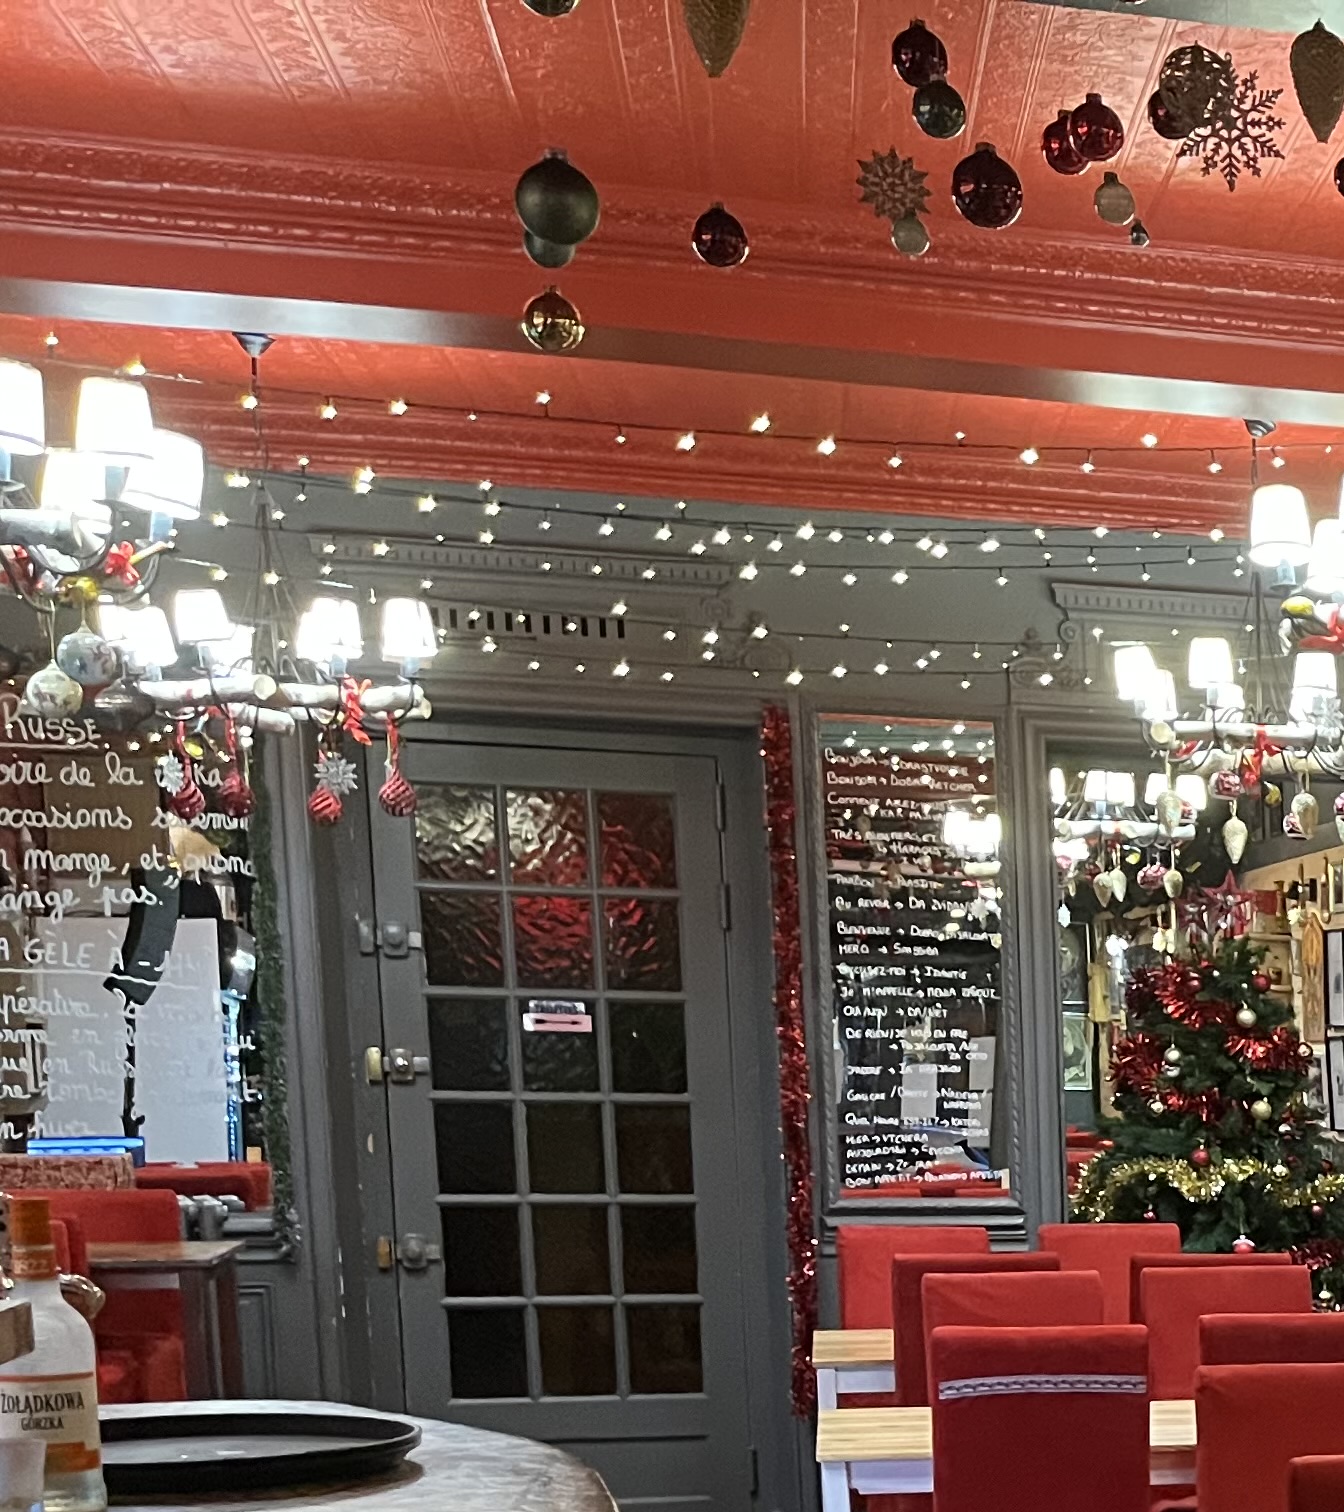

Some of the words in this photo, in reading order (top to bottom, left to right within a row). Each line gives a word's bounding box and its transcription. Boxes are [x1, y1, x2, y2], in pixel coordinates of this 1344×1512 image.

[60, 760, 95, 787] de
[105, 751, 144, 785] la
[140, 845, 165, 871] et
